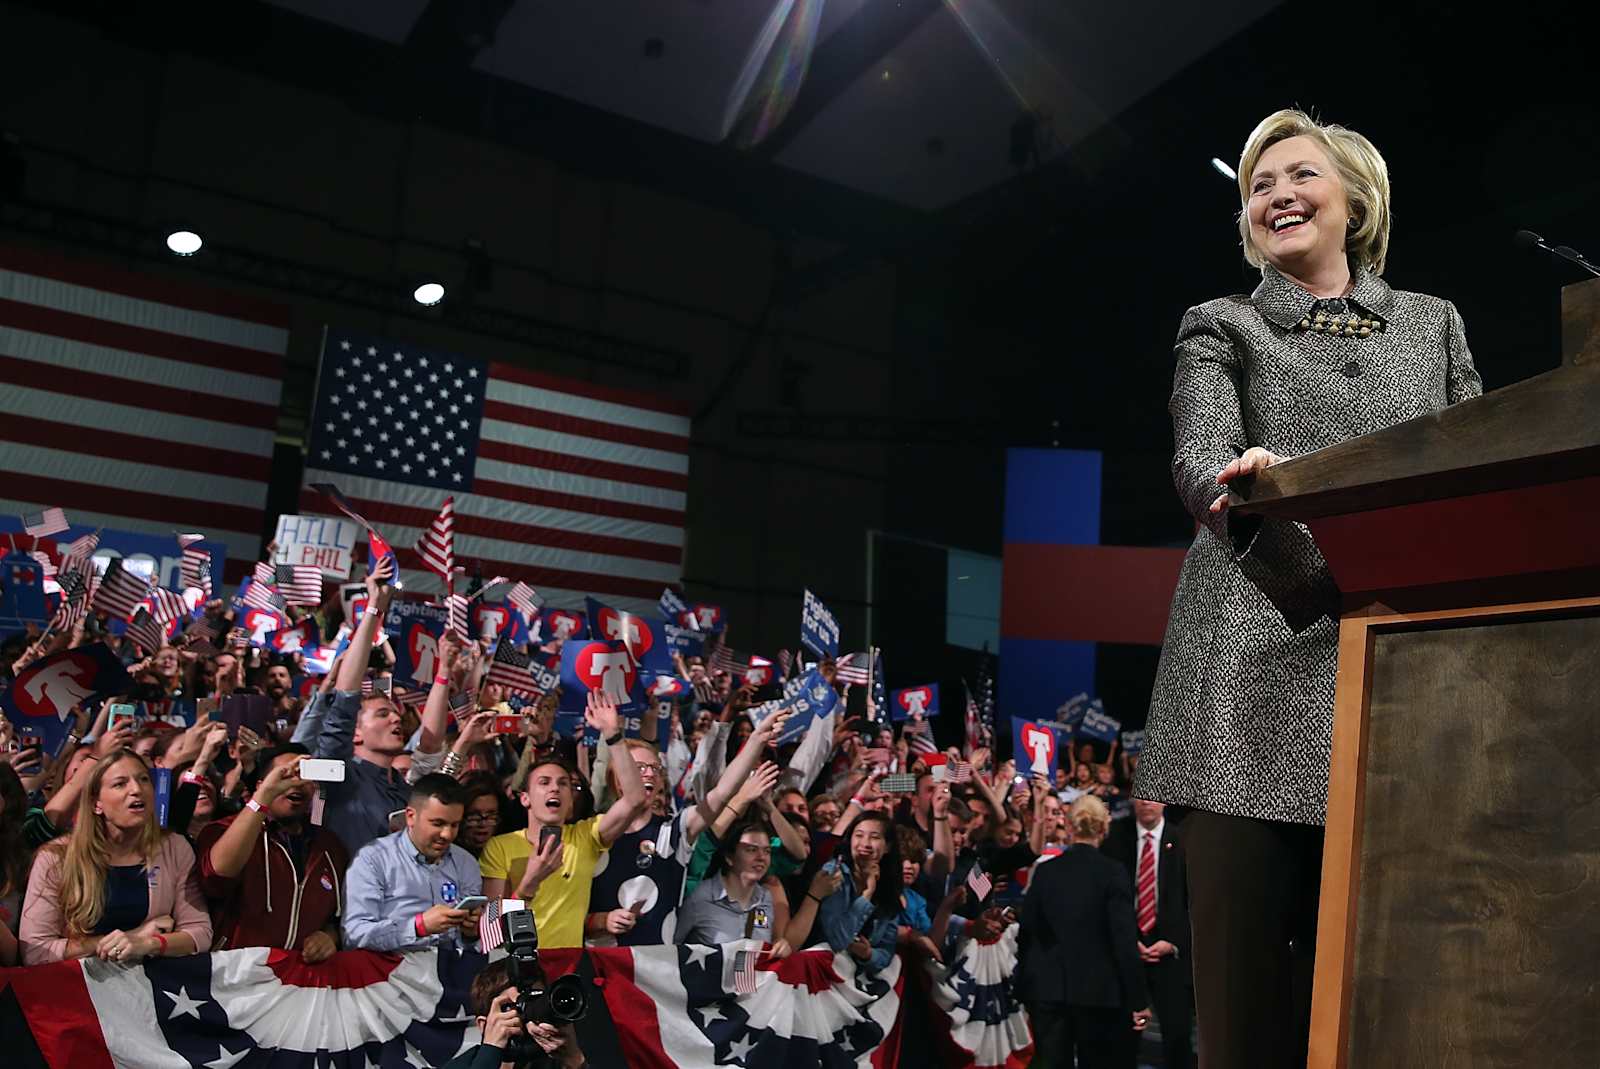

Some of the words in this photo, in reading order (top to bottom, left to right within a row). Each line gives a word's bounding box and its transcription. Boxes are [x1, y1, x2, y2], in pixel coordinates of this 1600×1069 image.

[280, 518, 348, 549] HILL
[302, 545, 346, 572] PHIL
[386, 613, 402, 624] fo
[390, 599, 448, 622] Fighting
[802, 607, 818, 633] for
[819, 625, 830, 645] us
[804, 589, 840, 644] Fighting
[747, 677, 811, 728] Fightin
